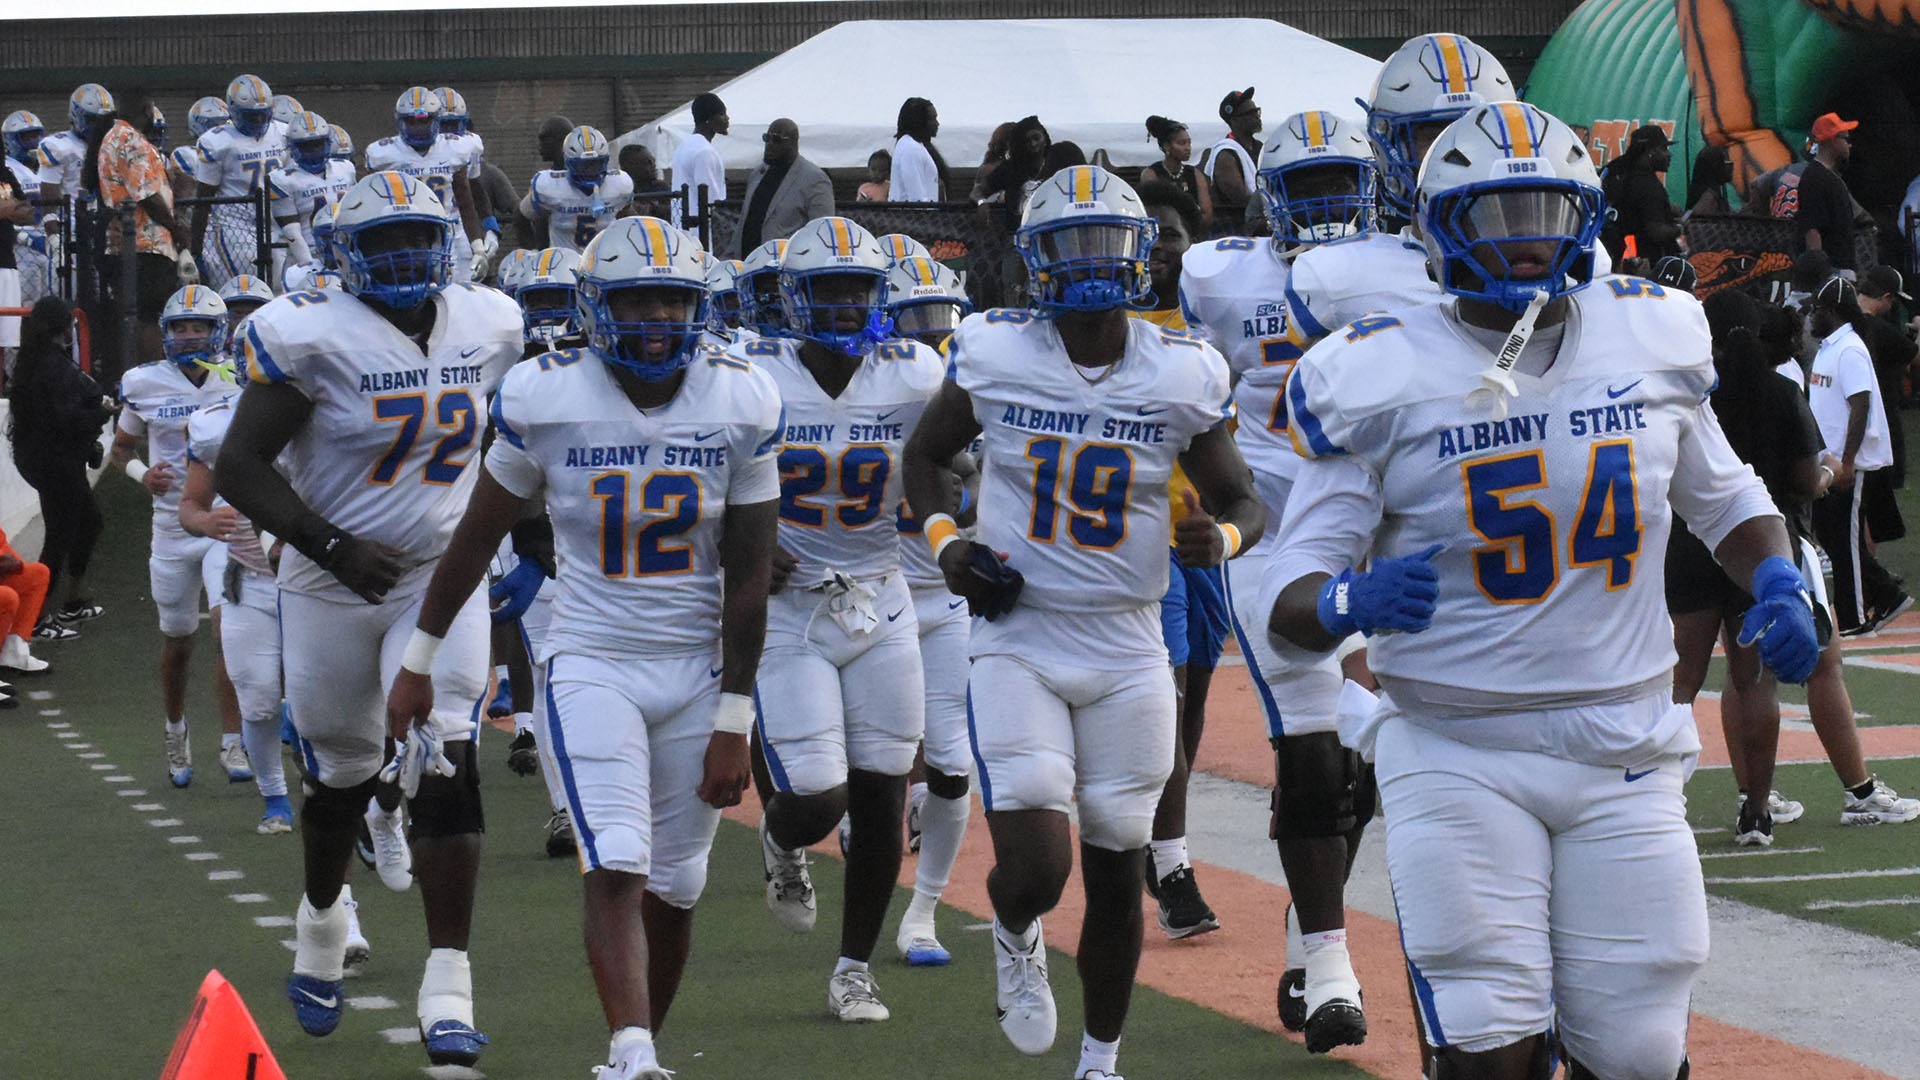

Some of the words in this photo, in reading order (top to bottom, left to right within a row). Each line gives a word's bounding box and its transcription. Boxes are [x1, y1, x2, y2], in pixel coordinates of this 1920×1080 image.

[1507, 162, 1537, 174] 1903
[1496, 334, 1525, 371] NXTRND
[359, 368, 428, 393] ALBANY
[440, 365, 483, 385] STATE
[367, 387, 479, 486] 72
[785, 424, 835, 442] BANY
[848, 422, 903, 441] STATE
[1001, 405, 1090, 434] ALBANY
[1102, 417, 1168, 443] STATE
[1438, 413, 1550, 459] ALBANY
[1570, 403, 1648, 437] STATE
[565, 444, 650, 468] ALBANY
[664, 446, 726, 467] STATE
[776, 442, 894, 531] 29
[1023, 435, 1136, 551] 19
[589, 470, 704, 579] 12
[1461, 438, 1645, 606] 54
[1335, 582, 1349, 615] NIKE
